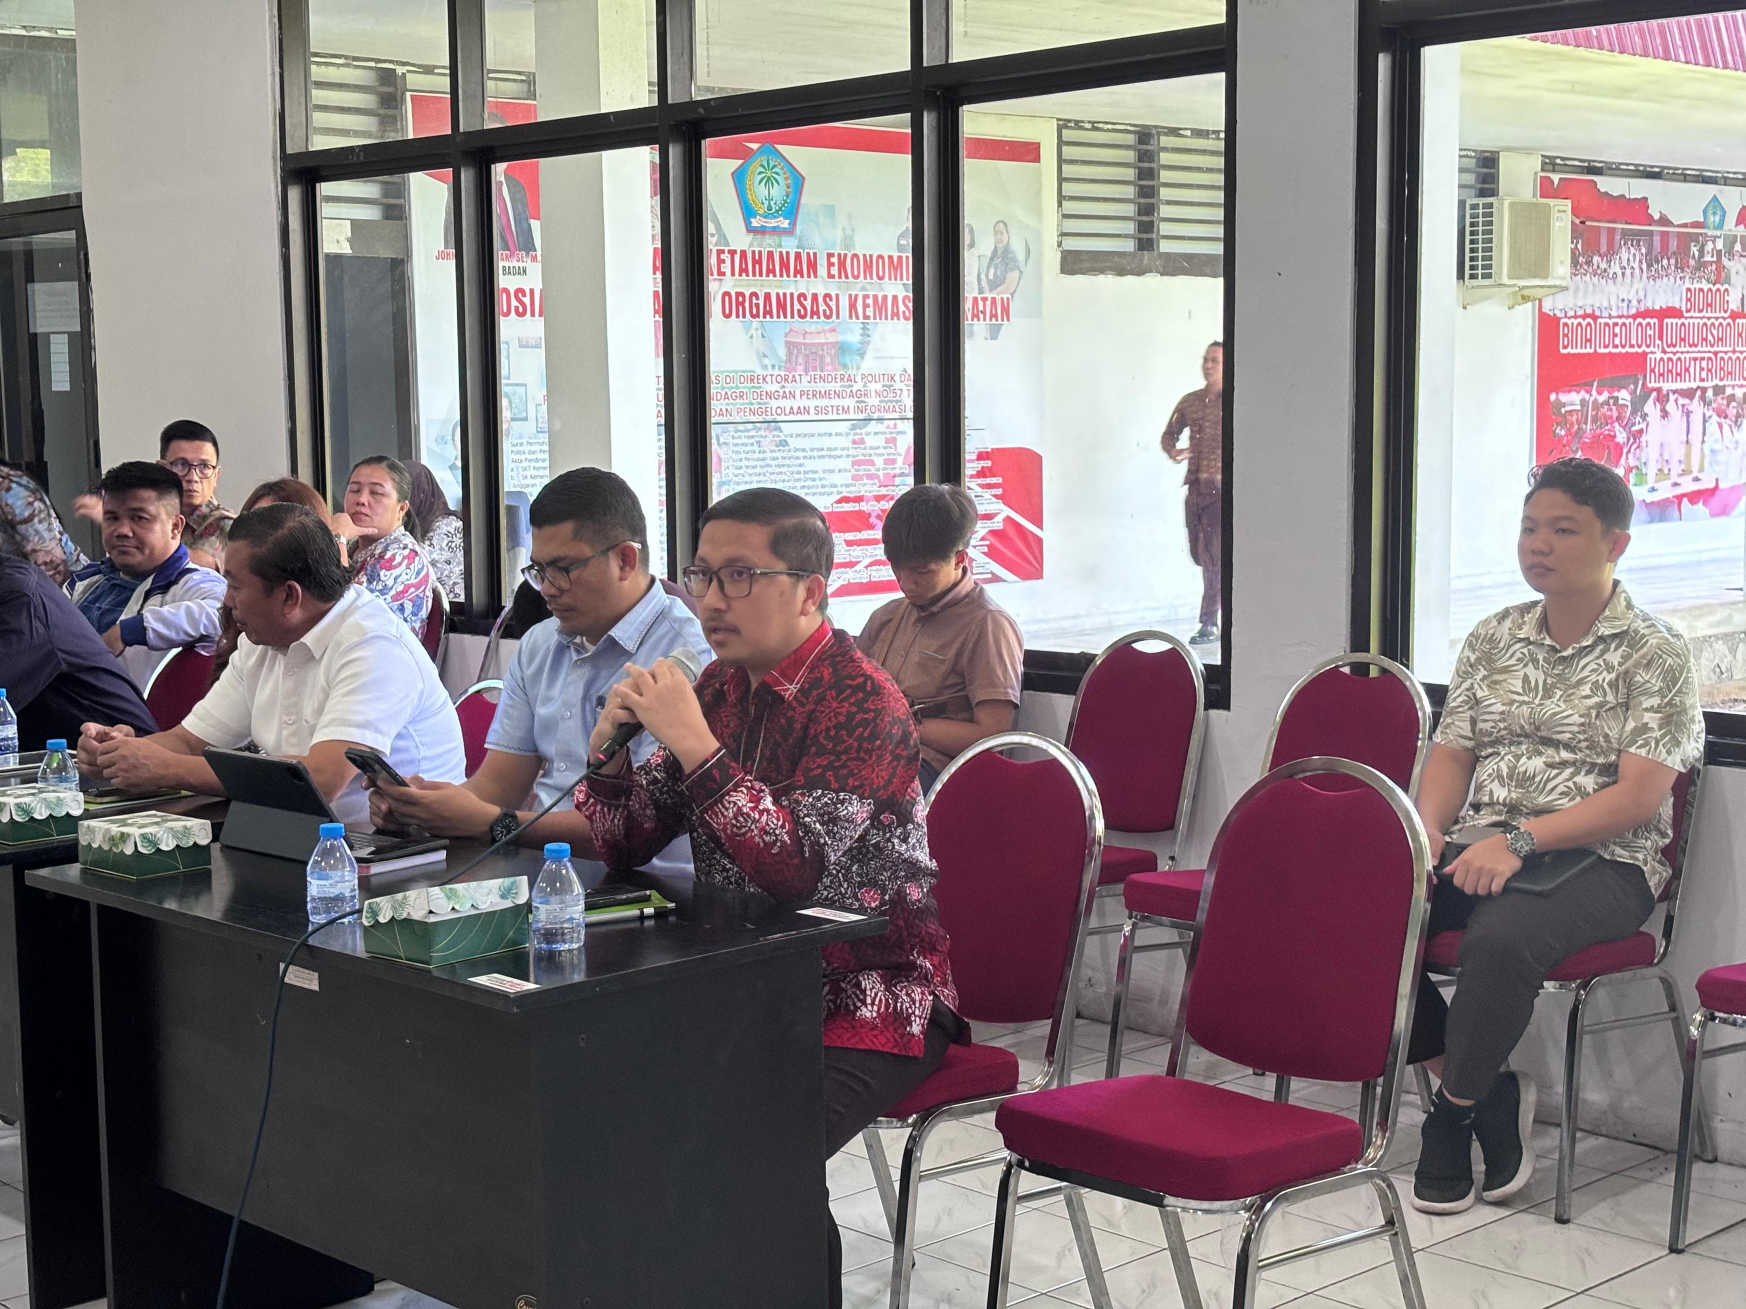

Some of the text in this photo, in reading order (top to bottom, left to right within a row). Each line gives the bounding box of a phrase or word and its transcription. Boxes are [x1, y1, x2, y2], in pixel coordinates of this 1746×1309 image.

[502, 265, 527, 277] BADAN
[826, 252, 910, 281] EKONOMI
[721, 290, 840, 321] ORGANISASI
[1686, 287, 1729, 314] BIDANG
[1562, 321, 1593, 350] BINA
[1666, 321, 1732, 349] WAWASAN
[739, 373, 804, 385] DIREKTORAT
[807, 373, 858, 384] JENDERAL
[861, 373, 896, 384] POLITIK
[1649, 356, 1713, 384] KARAKTER
[752, 389, 796, 401] DENGAN
[800, 389, 872, 401] PERMENDAGRI
[736, 405, 810, 418] PENGELOLAAN
[814, 404, 850, 416] SISTEM
[854, 403, 907, 415] INFORMASI
